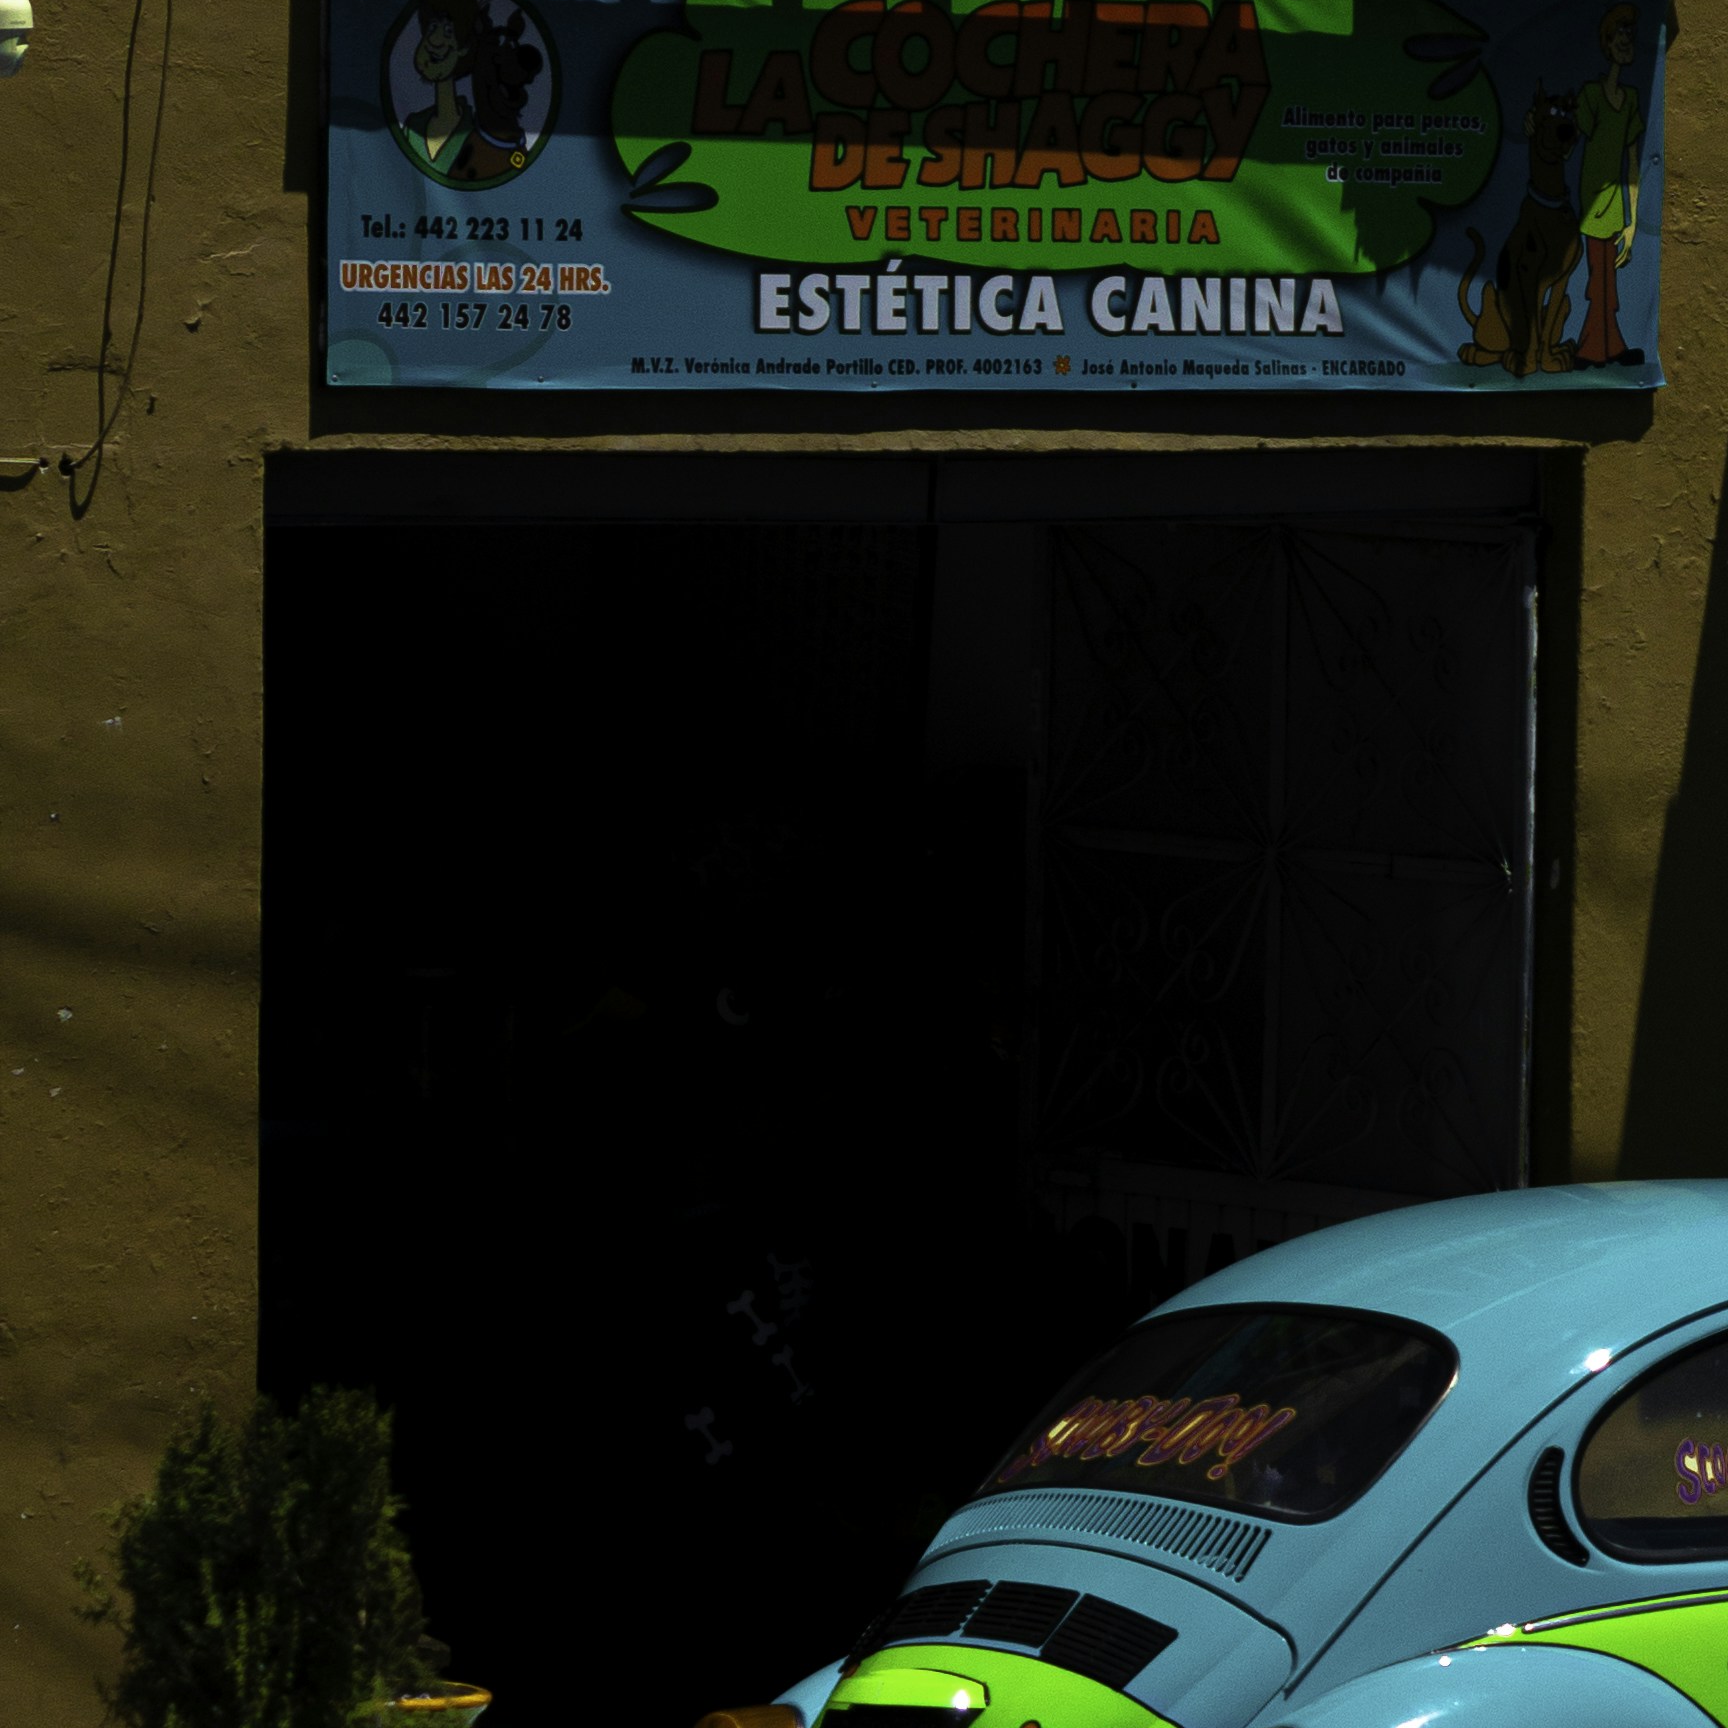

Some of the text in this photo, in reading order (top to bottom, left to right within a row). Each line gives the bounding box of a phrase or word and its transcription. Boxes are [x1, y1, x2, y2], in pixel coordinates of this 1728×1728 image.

[692, 49, 812, 135] LA
[1283, 106, 1487, 135] Alimento para perros,
[810, 85, 1271, 191] DE SHAGGY
[1305, 137, 1464, 160] gatos y animales
[1327, 162, 1349, 182] de
[361, 215, 583, 241] Tel.: 442 223 11 24
[845, 205, 1221, 244] VETERINARIA
[340, 261, 611, 294] URGENCIAS LAS 24 HRS.
[754, 258, 1345, 336] ESTÉTICA CANINA
[378, 302, 573, 330] 442 157 24 78
[631, 358, 679, 373] M.V.Z.
[684, 358, 749, 374] Verónica
[756, 357, 820, 374] Andrade
[826, 358, 882, 375] Portillo
[888, 358, 920, 375] CED.
[925, 358, 967, 375] PROF.
[972, 359, 1043, 375] 4002163
[1082, 359, 1114, 375] José
[1120, 359, 1177, 376] Antonio
[1183, 359, 1249, 378] Maqueda
[1254, 360, 1307, 376] Salinas
[1322, 359, 1406, 377] ENCARGADO
